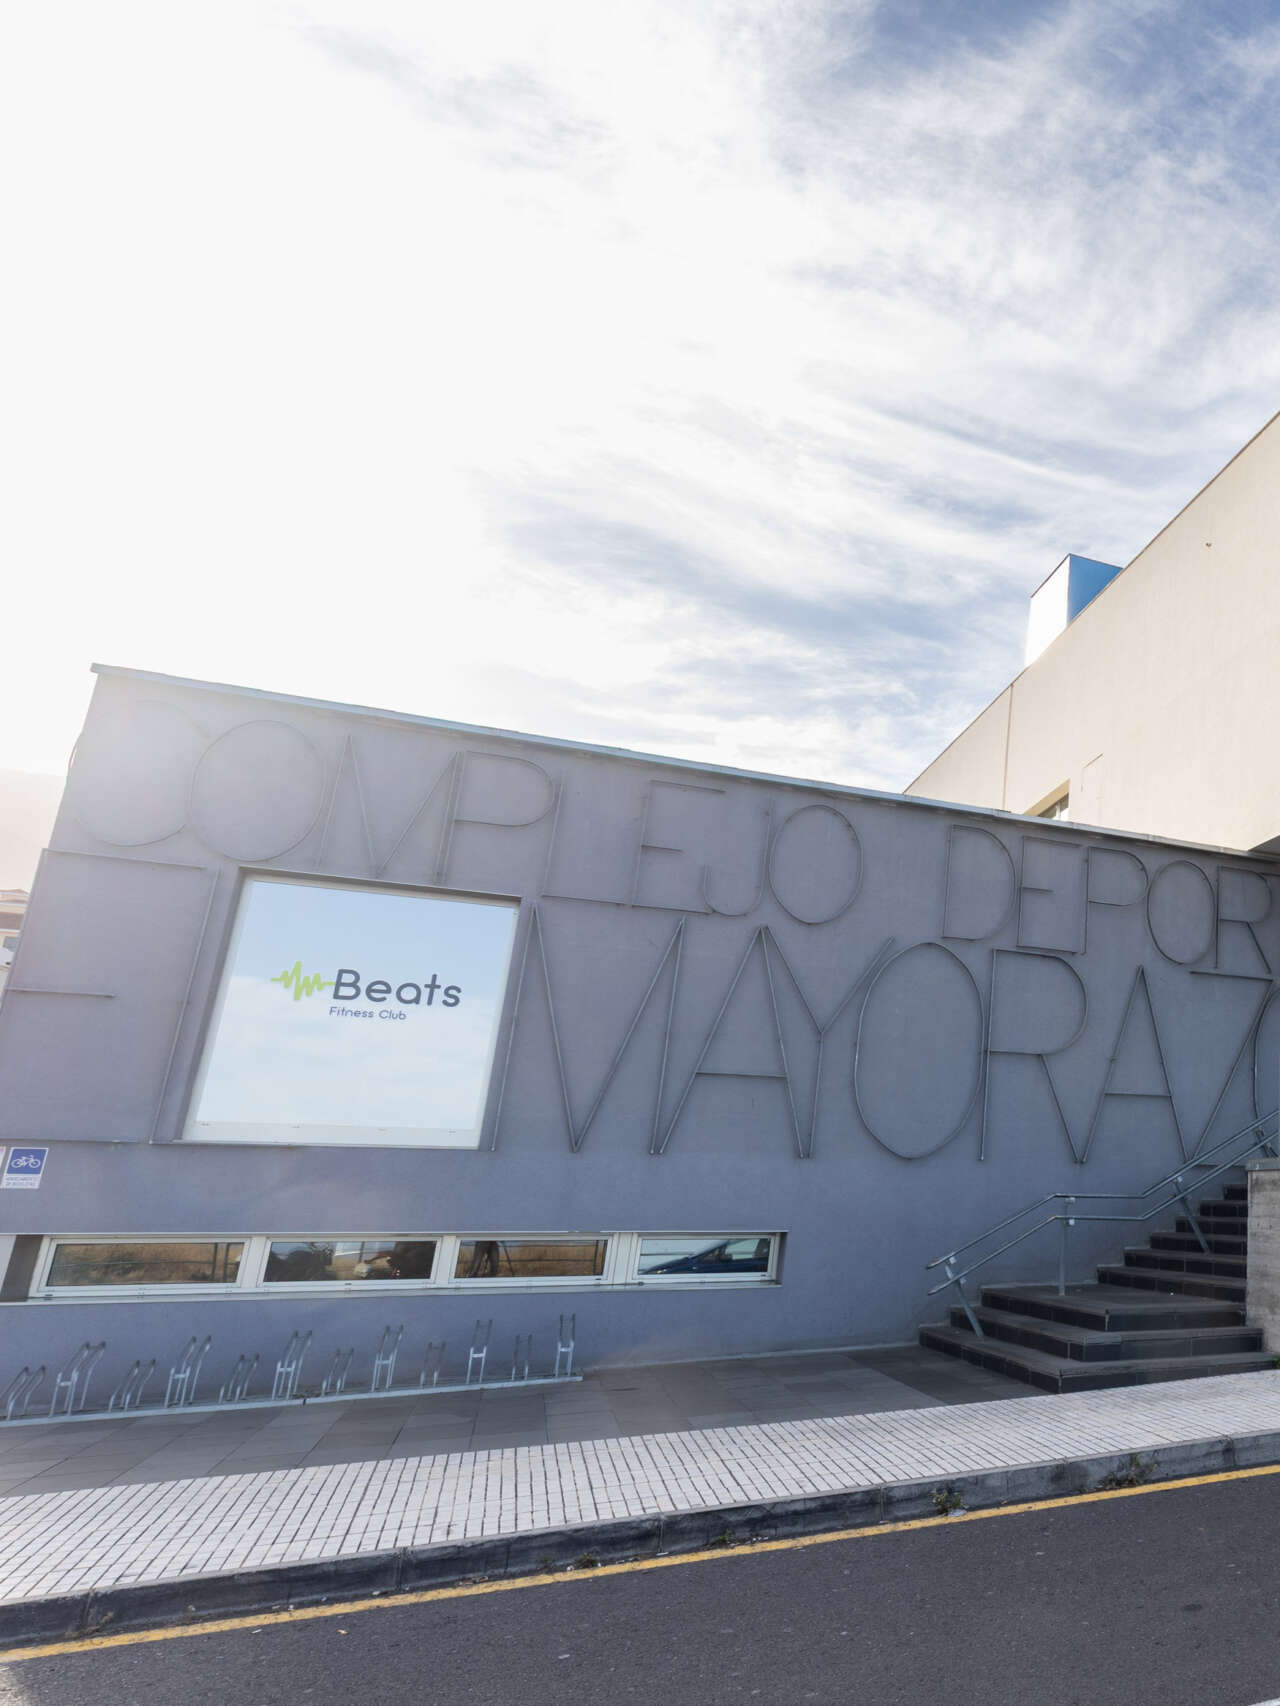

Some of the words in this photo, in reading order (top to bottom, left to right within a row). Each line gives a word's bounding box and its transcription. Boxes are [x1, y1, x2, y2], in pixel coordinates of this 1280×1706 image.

[67, 699, 863, 925] COMPLEJO
[332, 968, 462, 1008] Beats
[328, 1006, 374, 1019] Fitness
[378, 1009, 407, 1020] Club
